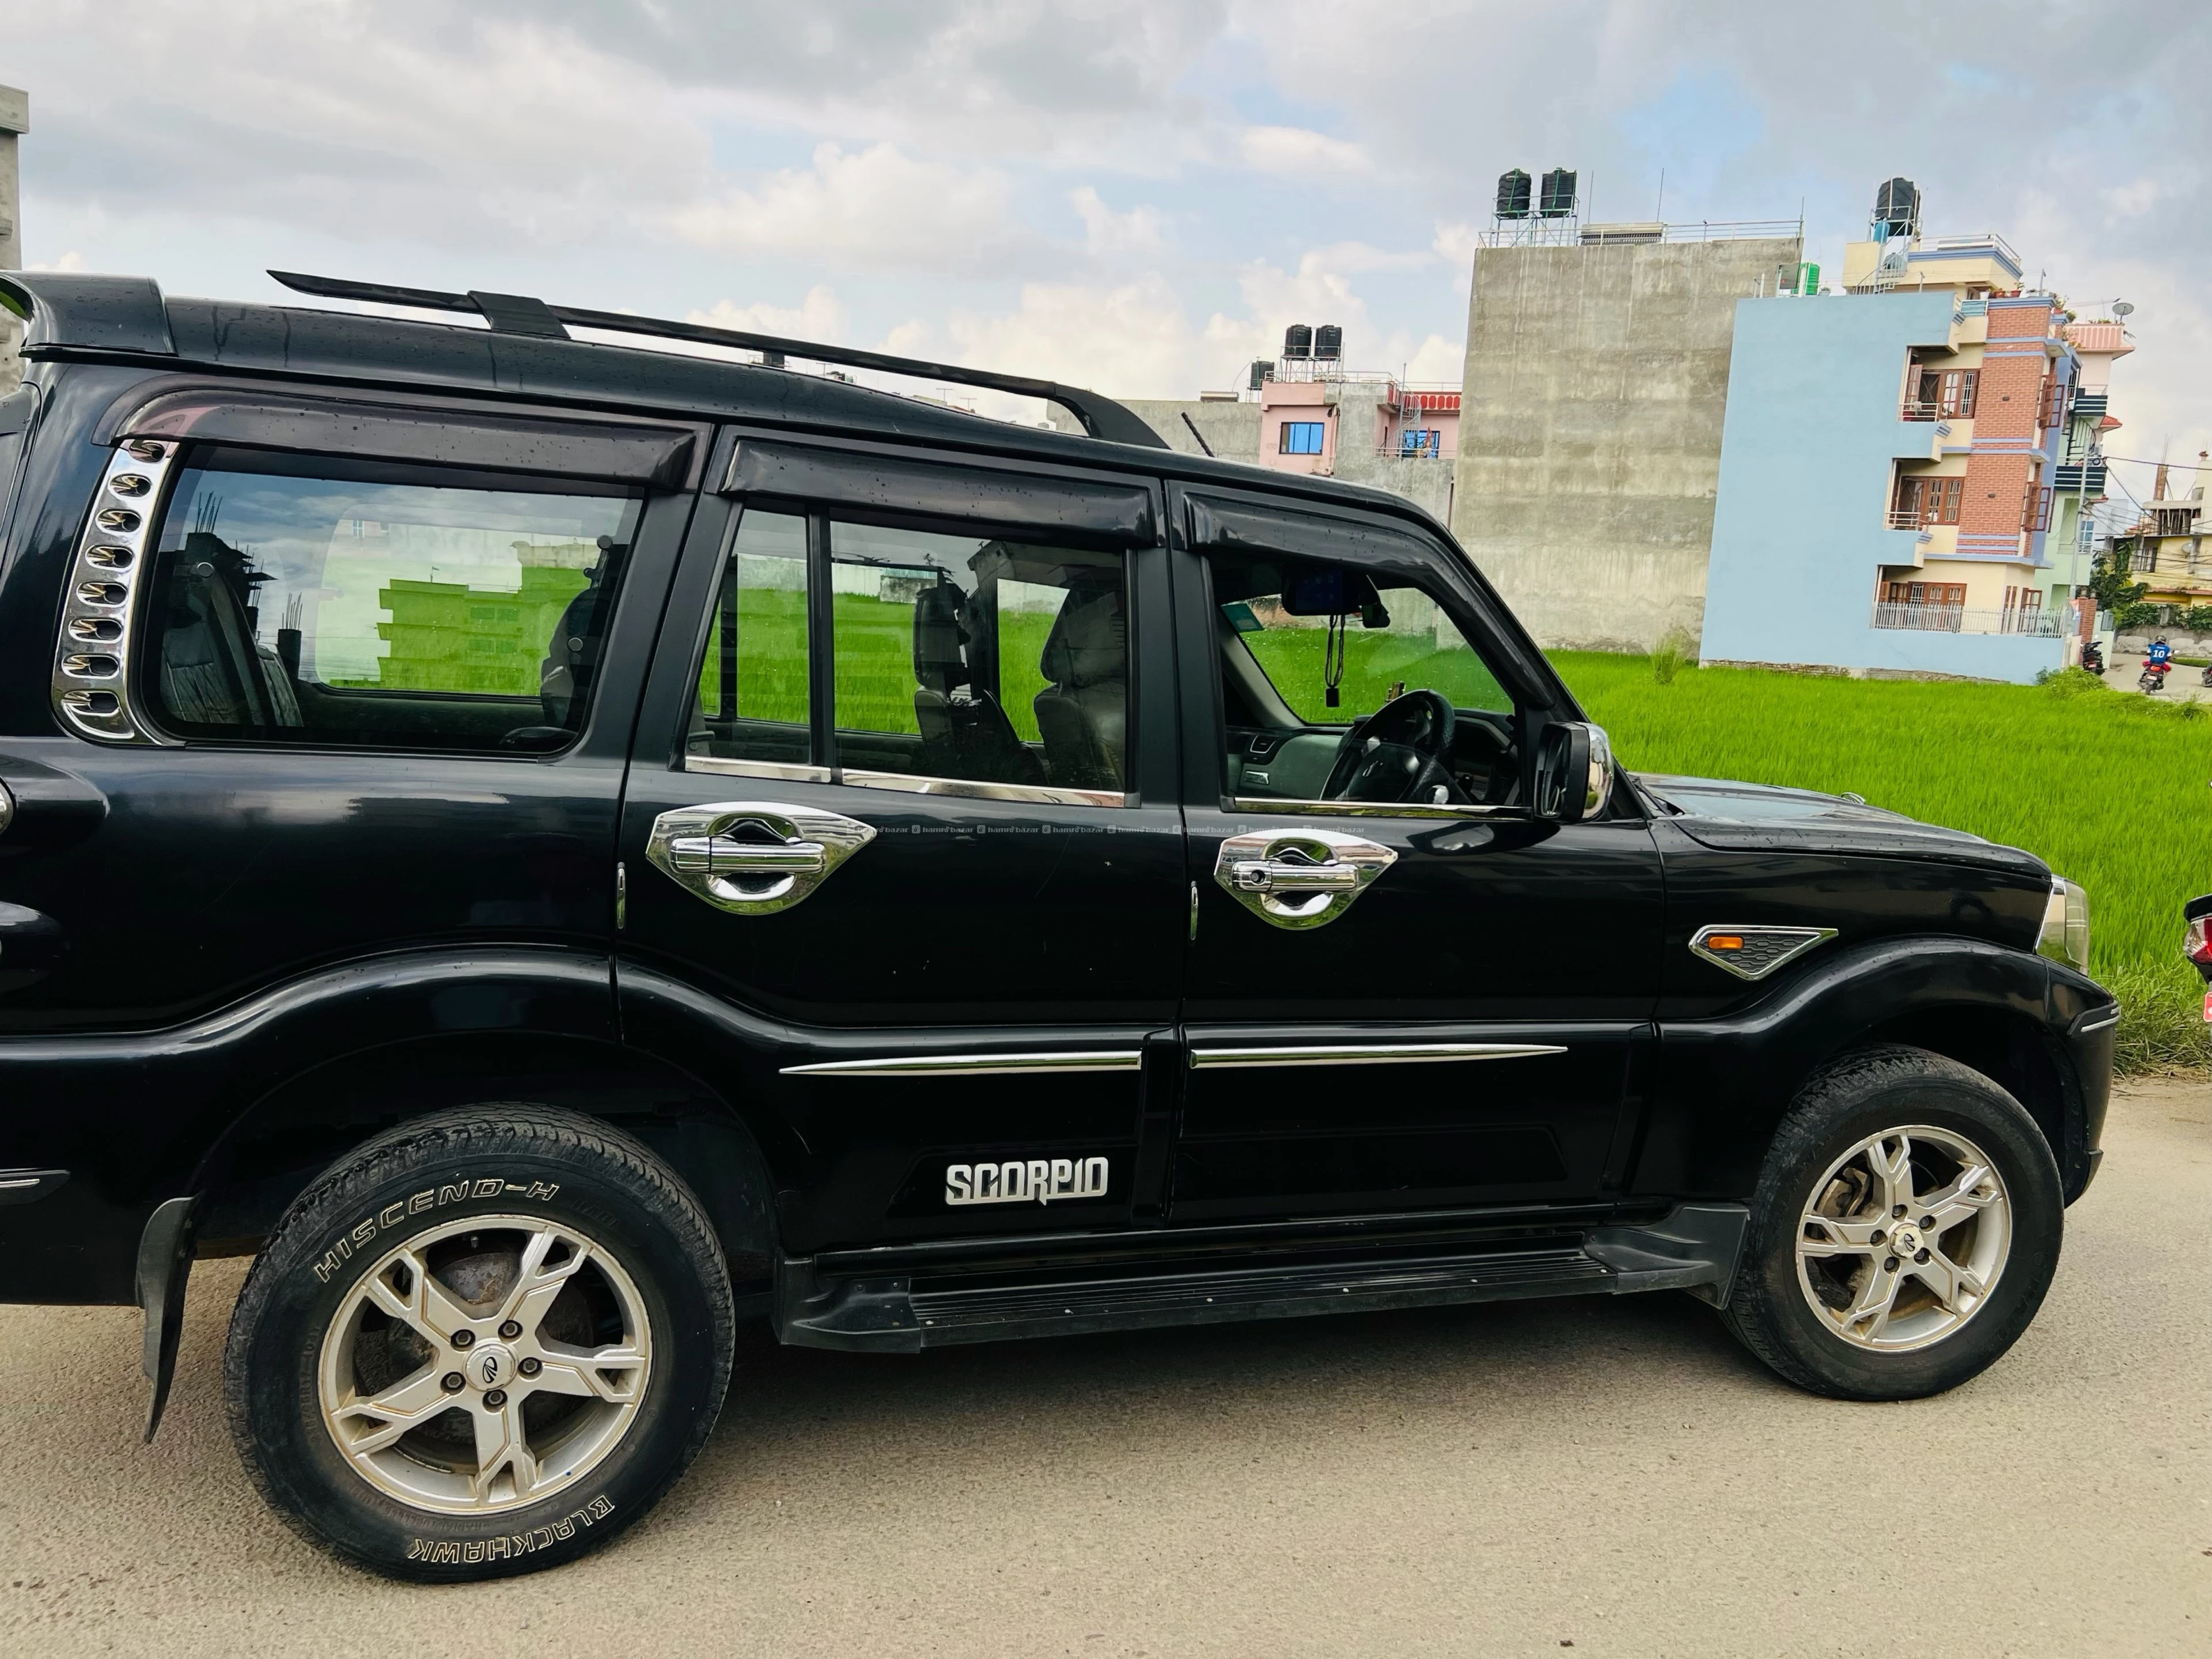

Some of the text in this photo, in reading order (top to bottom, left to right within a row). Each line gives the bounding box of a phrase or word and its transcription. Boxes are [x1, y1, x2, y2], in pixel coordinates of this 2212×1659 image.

[2153, 650, 2165, 658] 10
[945, 1156, 1109, 1206] SCORPIO
[313, 1178, 560, 1283] HISCEND-H
[407, 1494, 616, 1565] BLACKHAWK
